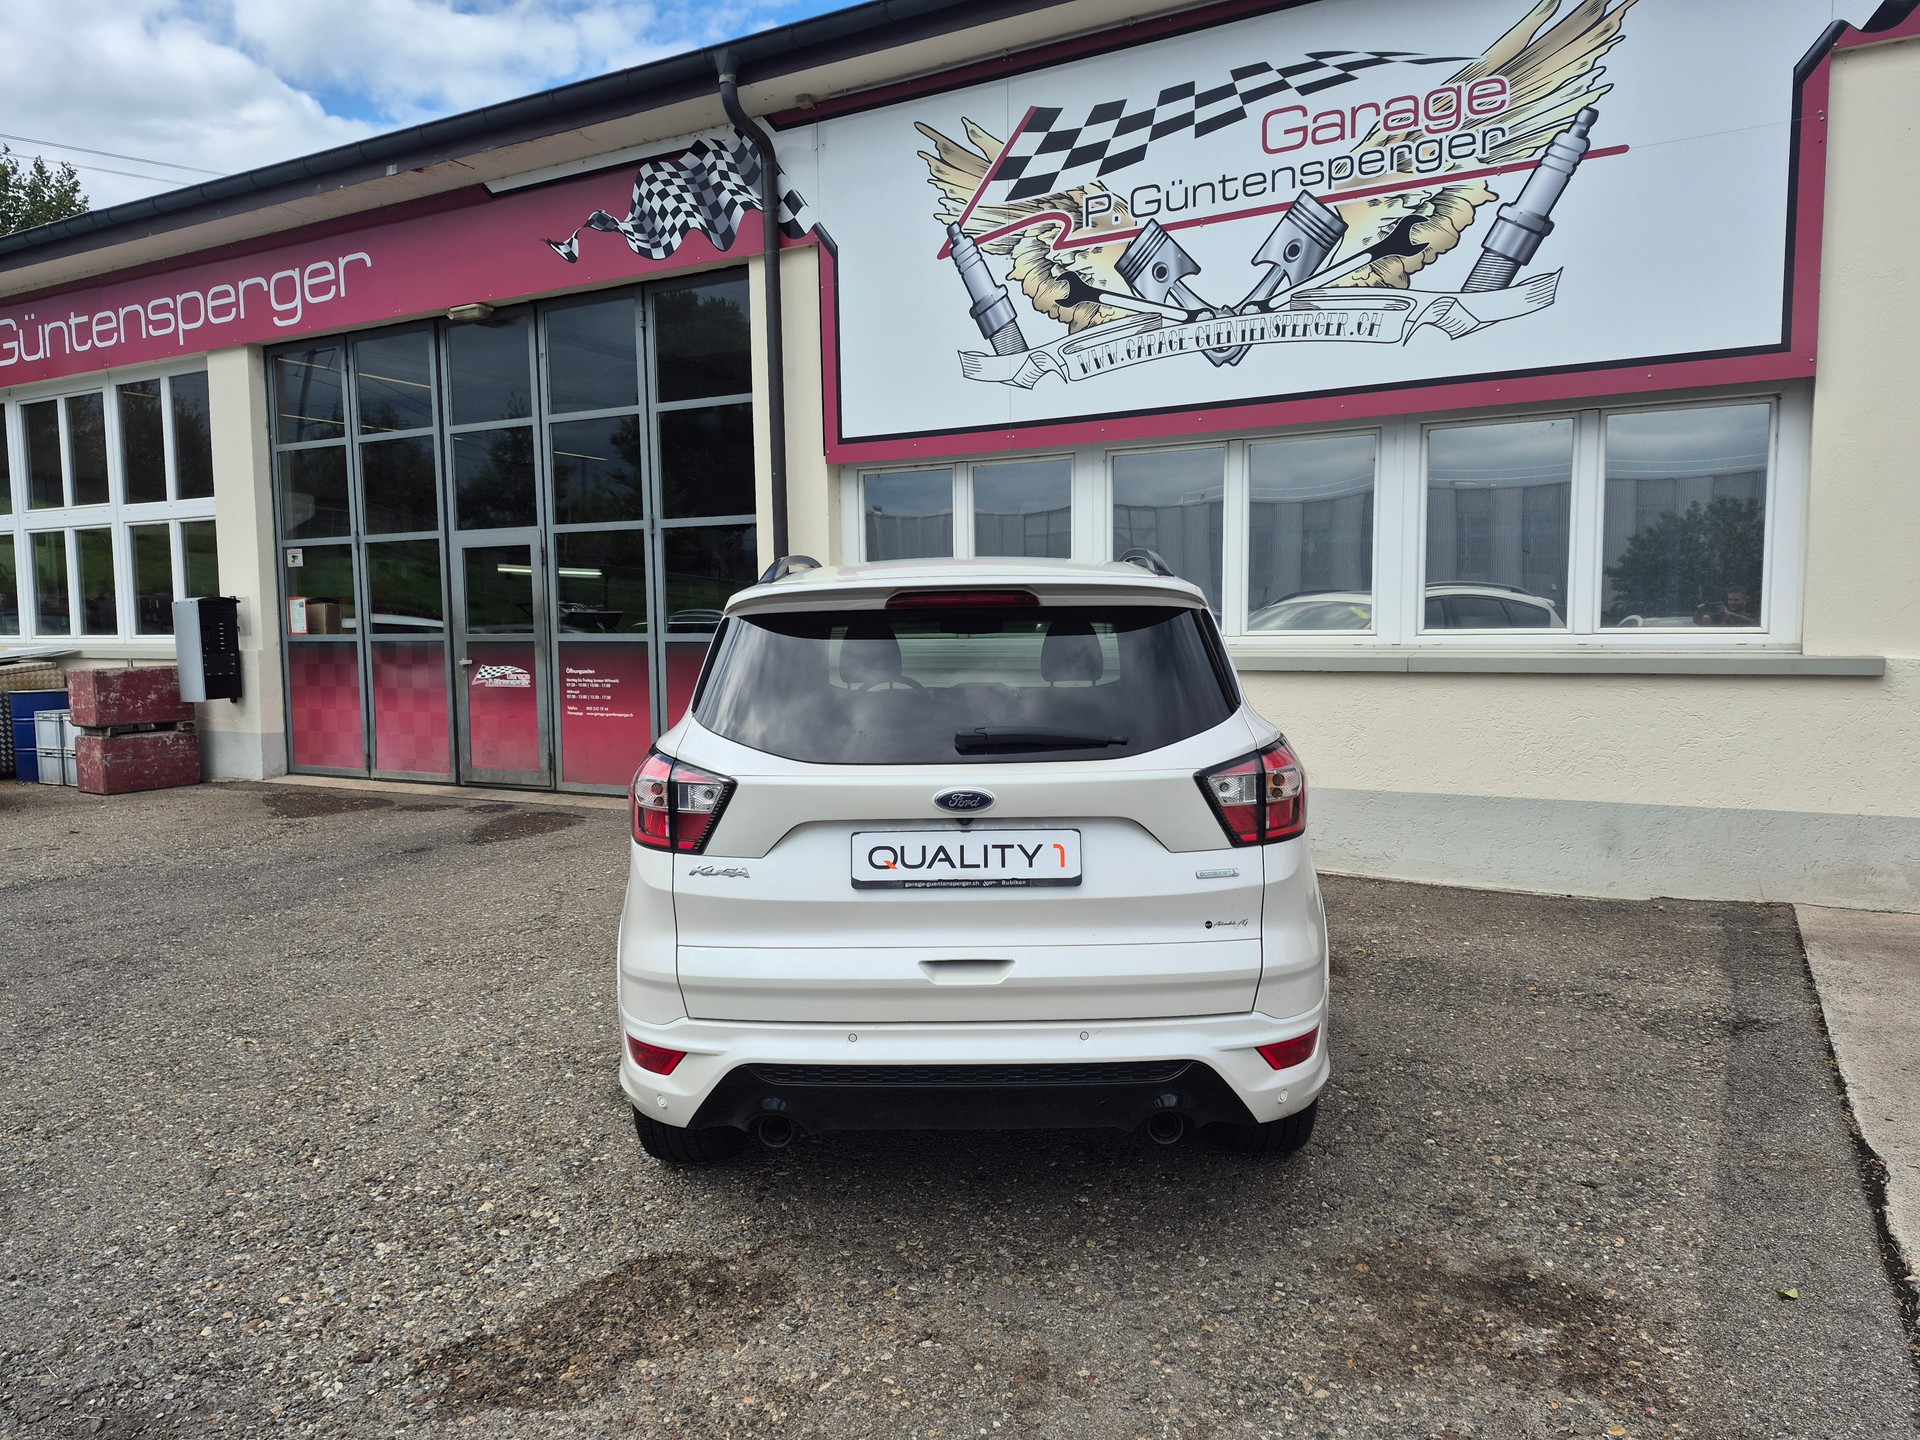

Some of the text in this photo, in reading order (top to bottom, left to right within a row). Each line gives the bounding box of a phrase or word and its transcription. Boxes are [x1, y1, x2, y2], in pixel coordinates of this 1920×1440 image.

[1262, 78, 1508, 155] Garage
[1076, 311, 1385, 375] WWW.GARAGE-GUENTENSPERGER.CH
[948, 793, 981, 807] Ford
[868, 844, 1066, 870] QUALITY 1
